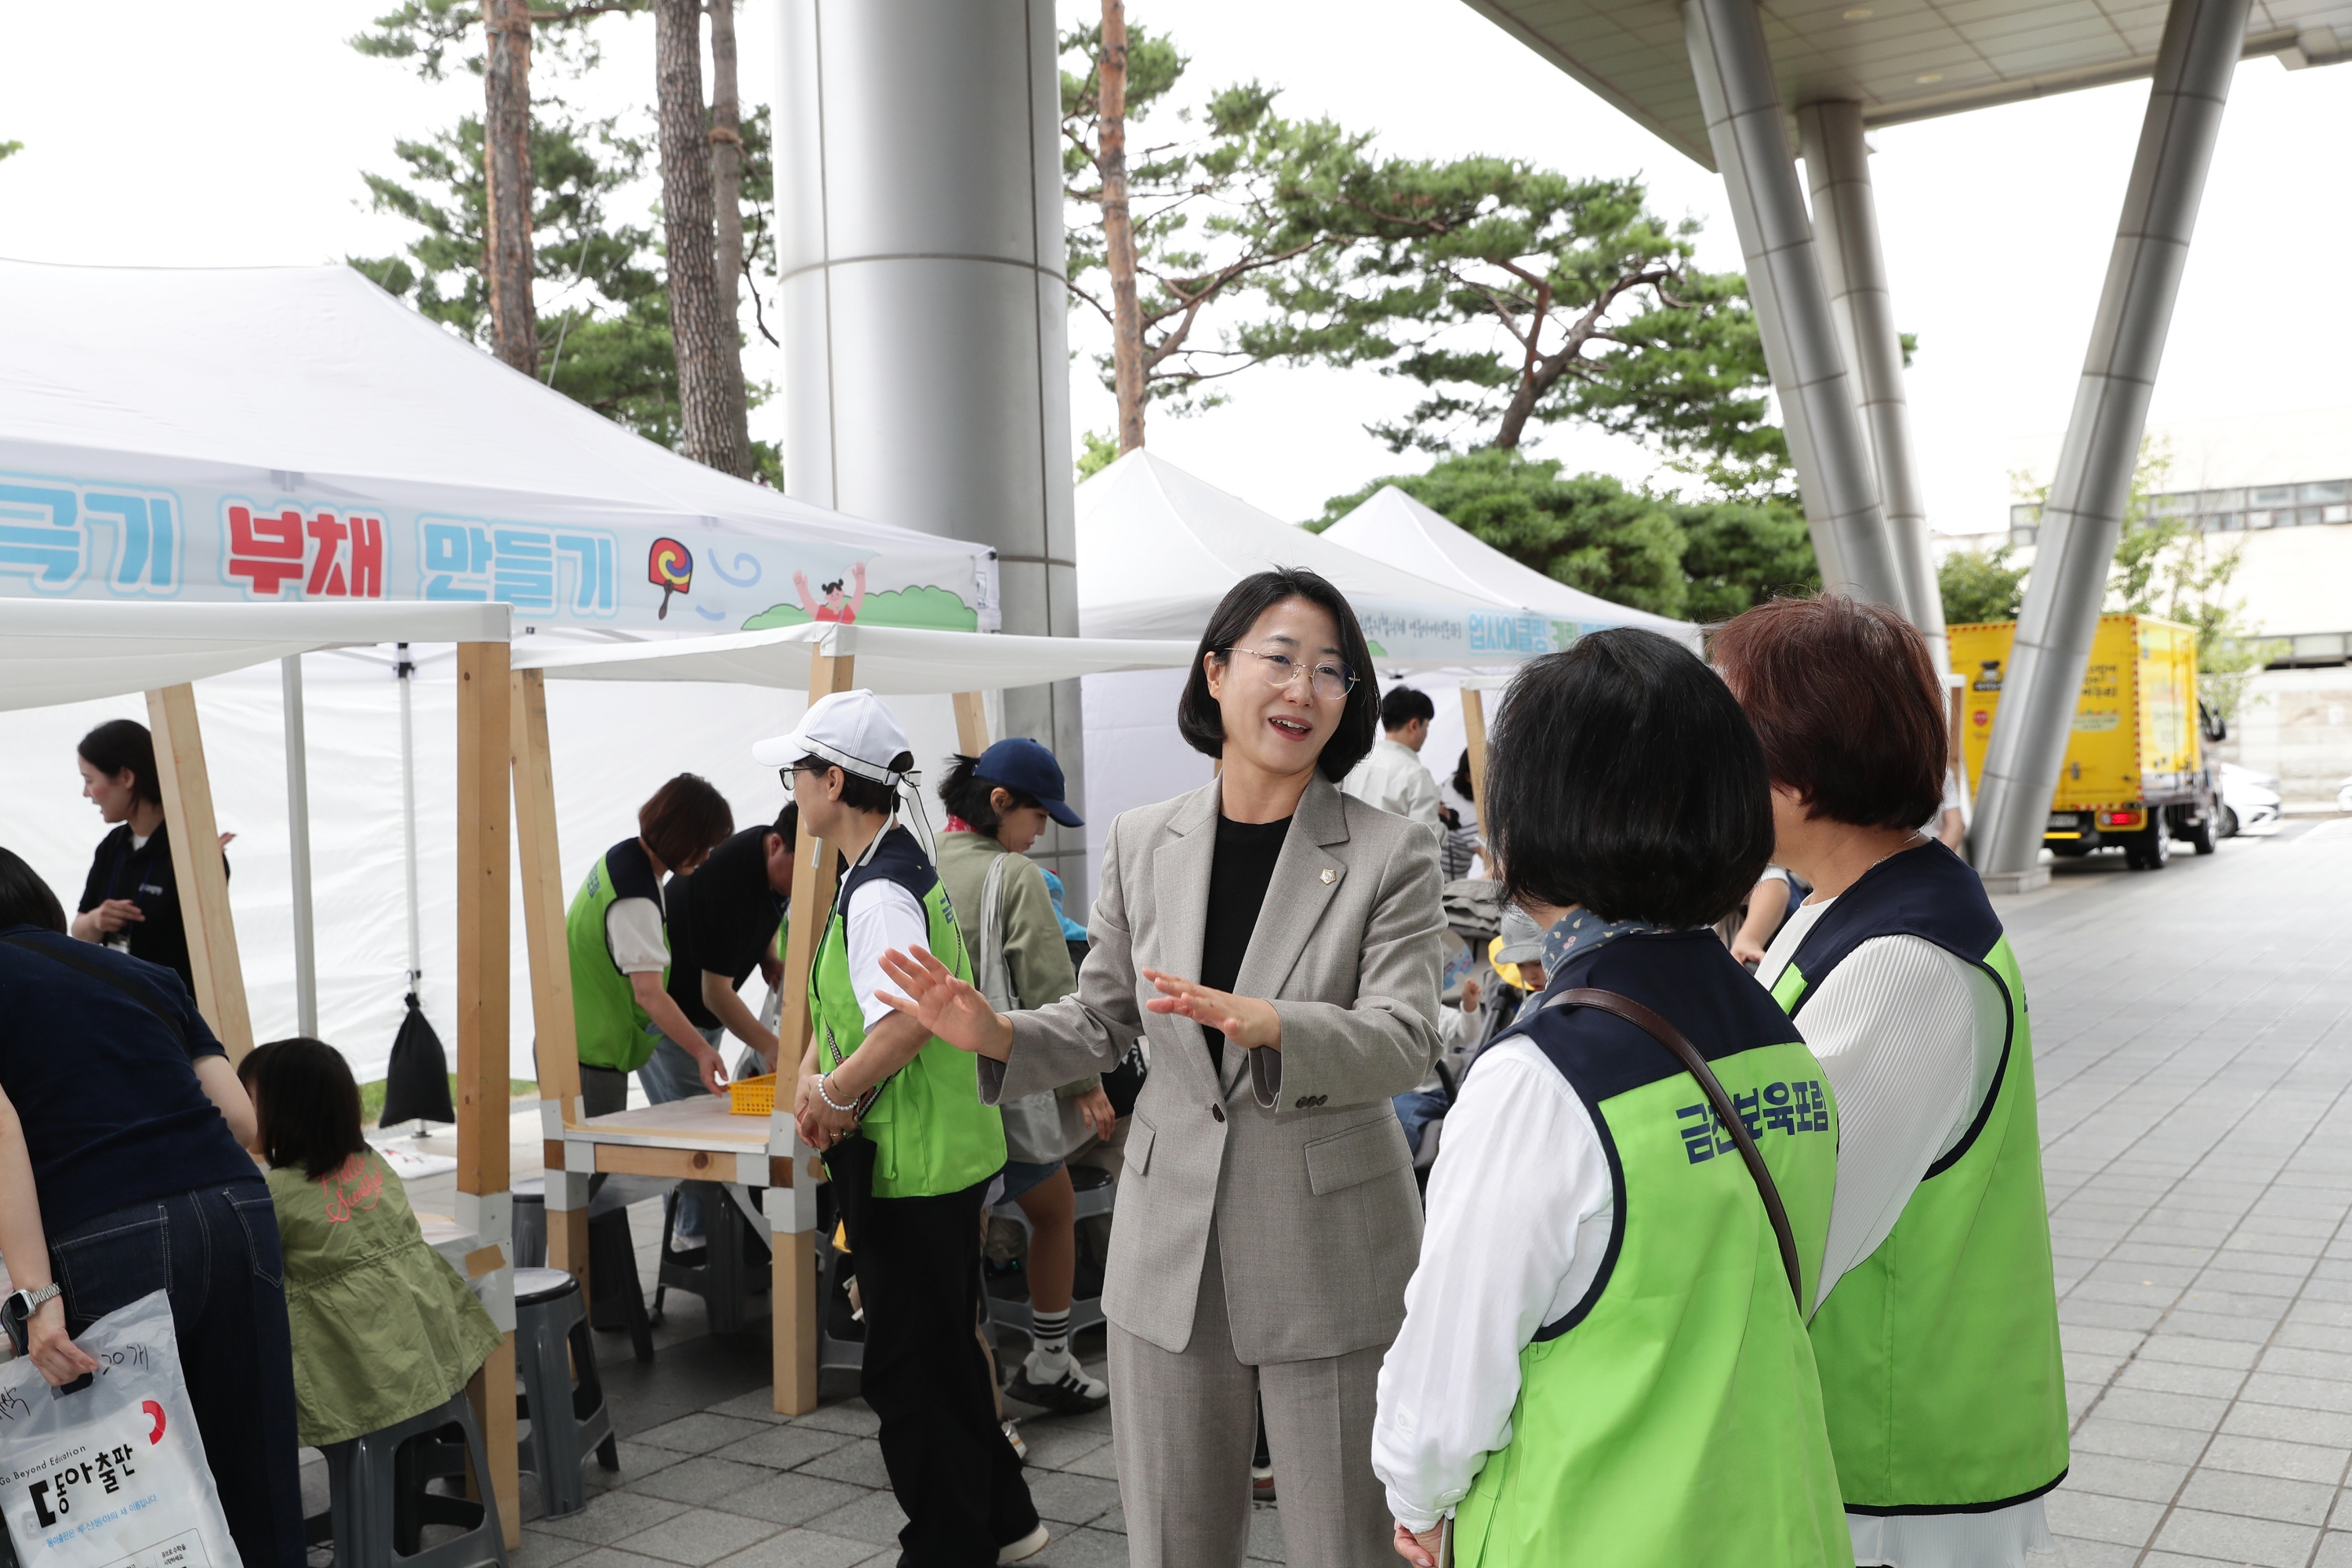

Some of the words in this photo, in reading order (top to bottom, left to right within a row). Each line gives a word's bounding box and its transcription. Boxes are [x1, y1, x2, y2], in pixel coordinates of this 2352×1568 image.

[228, 506, 383, 598] 부채
[424, 523, 614, 610] 만들기
[1468, 613, 1548, 653] 업사이클링
[13, 1460, 47, 1480] Beyond
[54, 1444, 136, 1515] 동아출판
[46, 1529, 76, 1548] 동아출판은
[78, 1511, 119, 1534] 두산동아의
[120, 1507, 128, 1515] 새
